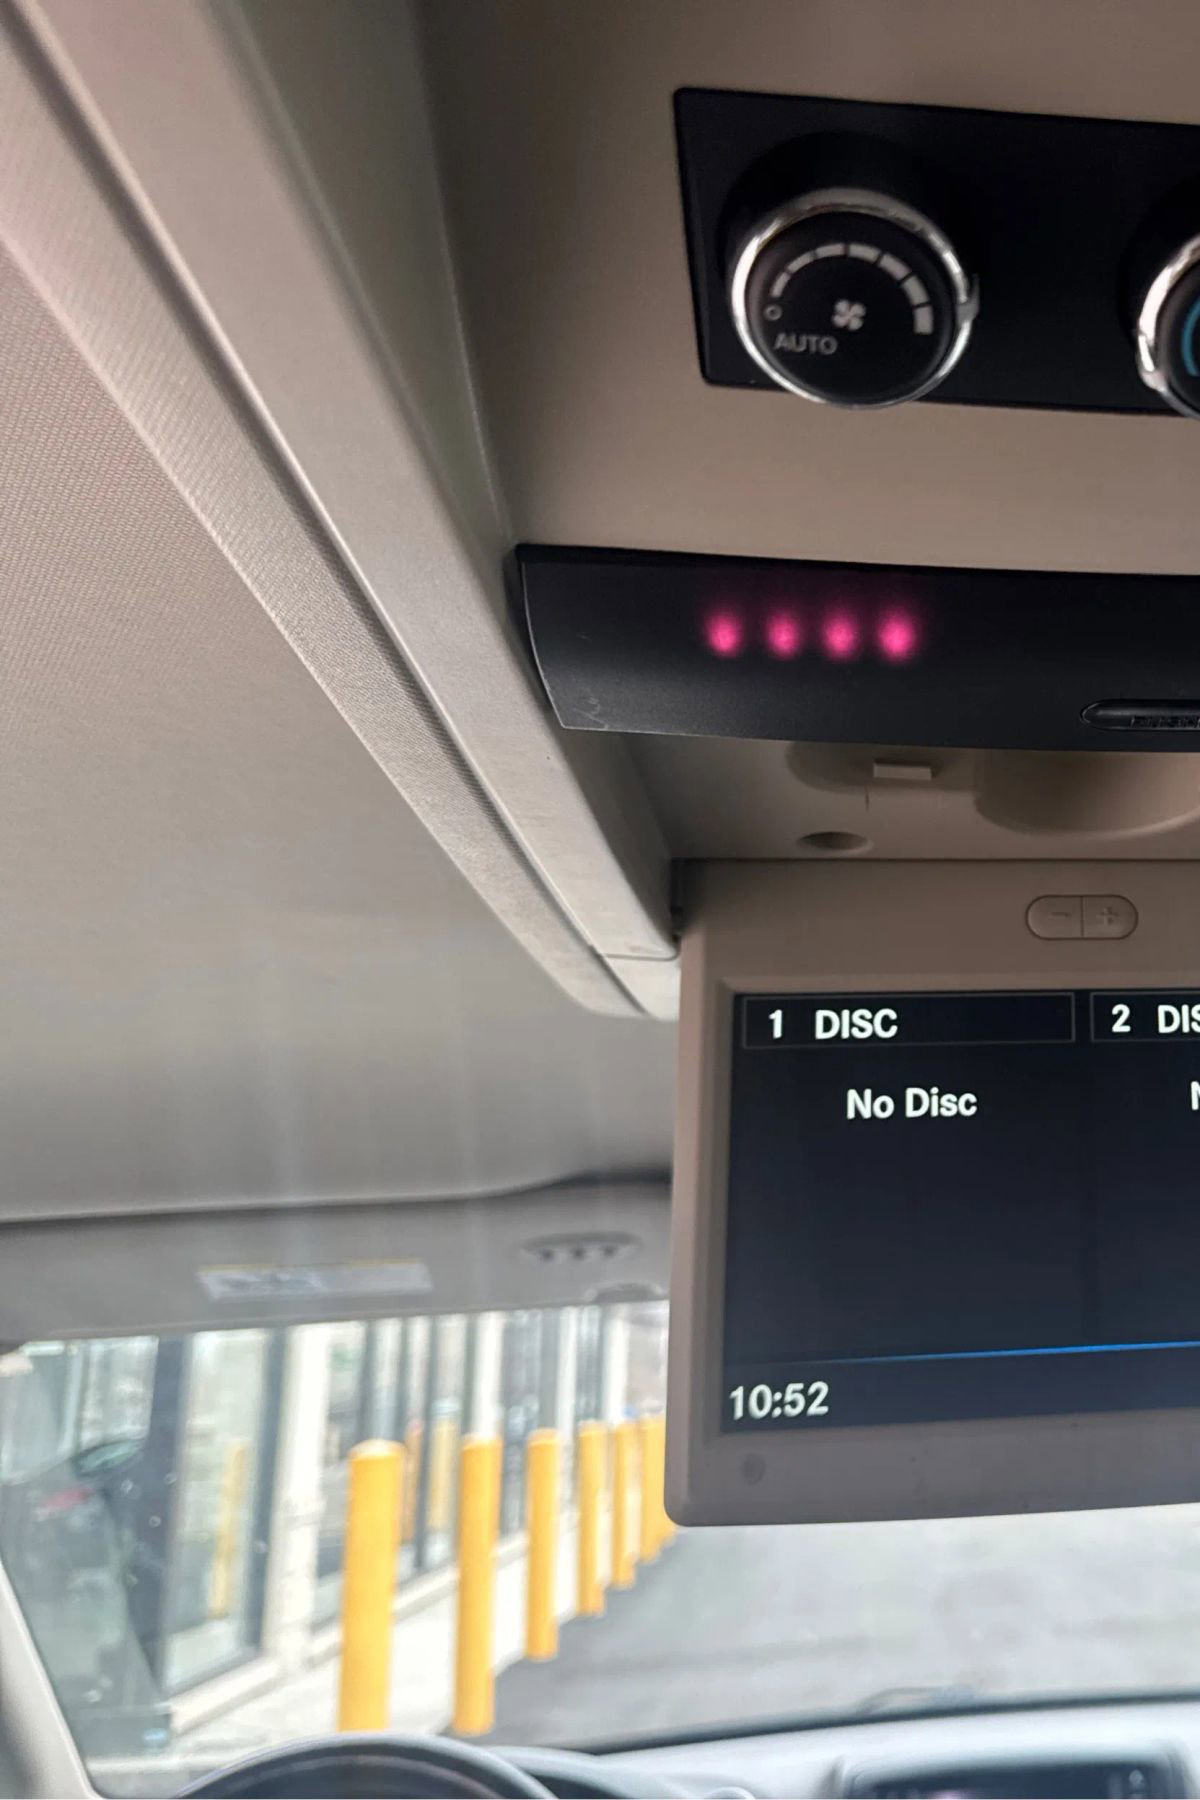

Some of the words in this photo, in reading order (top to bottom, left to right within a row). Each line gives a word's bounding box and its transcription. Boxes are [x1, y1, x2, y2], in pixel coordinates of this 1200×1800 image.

[774, 332, 838, 355] AUTO
[768, 1008, 783, 1039] 1
[814, 1007, 898, 1040] DISC
[1111, 1003, 1131, 1033] 2
[846, 1088, 895, 1120] No
[905, 1086, 978, 1118] Disc
[729, 1380, 829, 1420] 10:52
